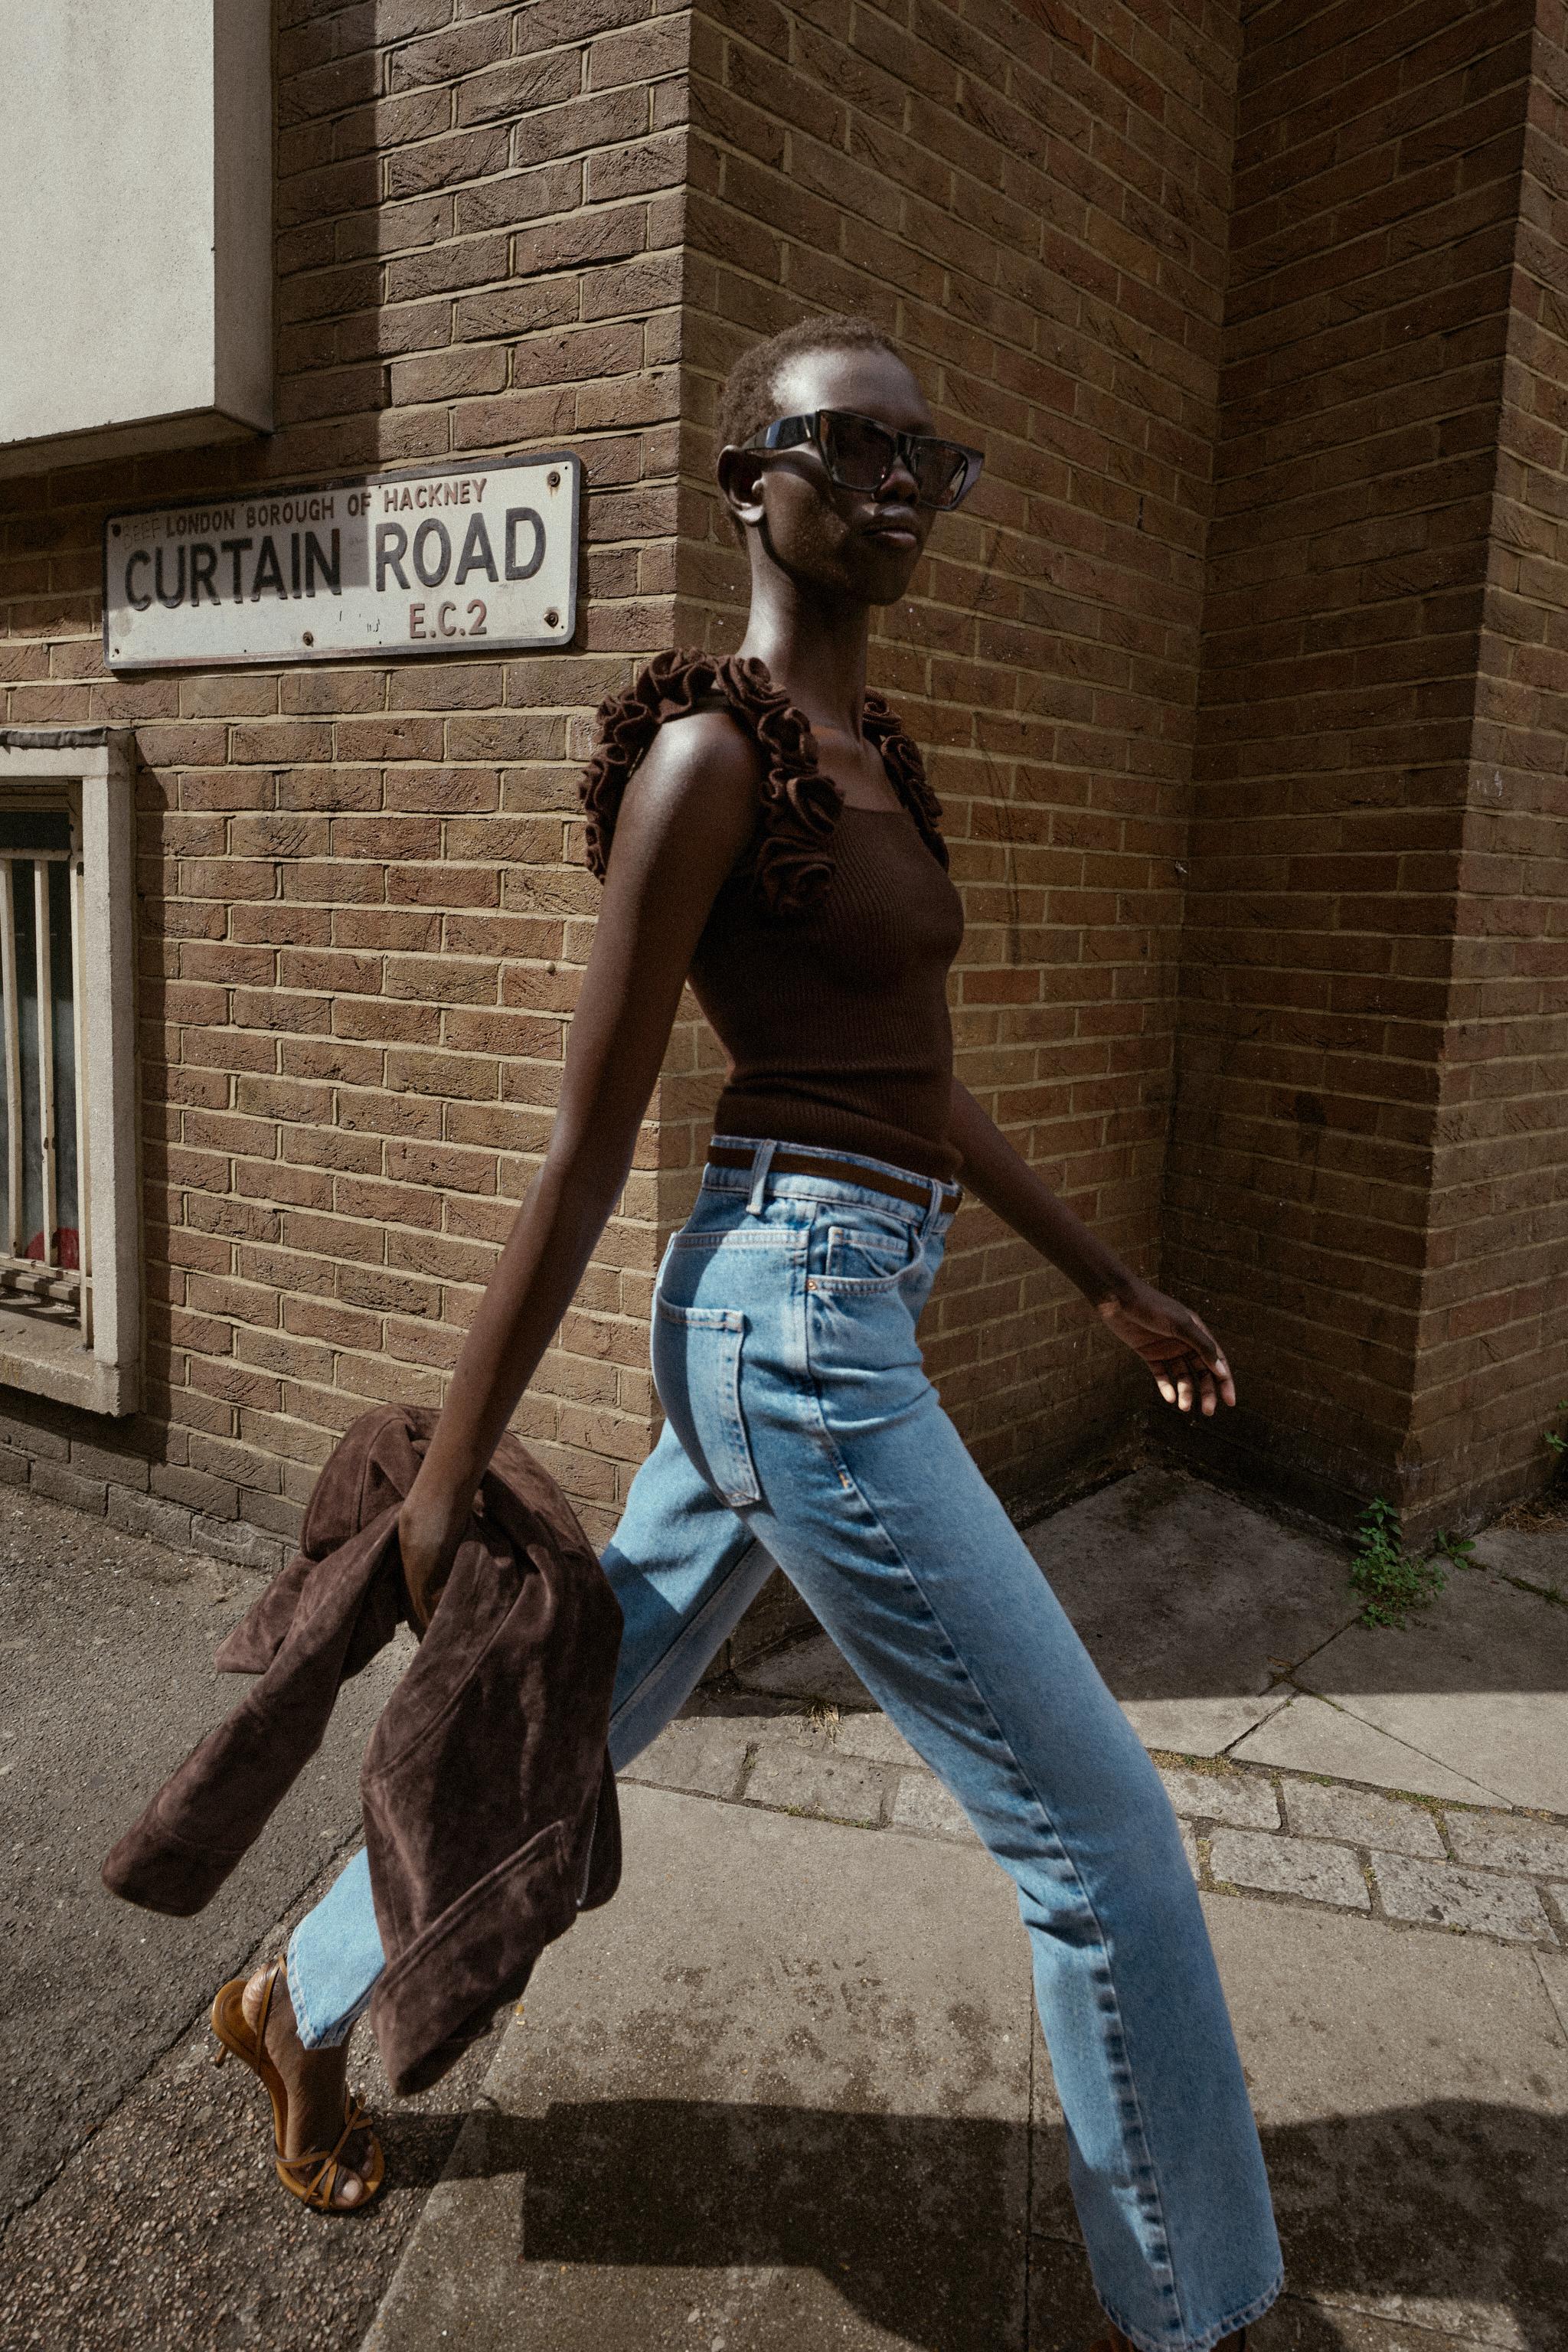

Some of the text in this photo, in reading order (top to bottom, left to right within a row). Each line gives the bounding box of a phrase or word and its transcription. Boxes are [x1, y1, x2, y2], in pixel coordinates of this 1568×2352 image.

[166, 478, 487, 537] LONDON BOROUGH OF HACKNEY
[125, 507, 547, 611] CURTAIN ROAD
[410, 599, 488, 639] E.C.2
